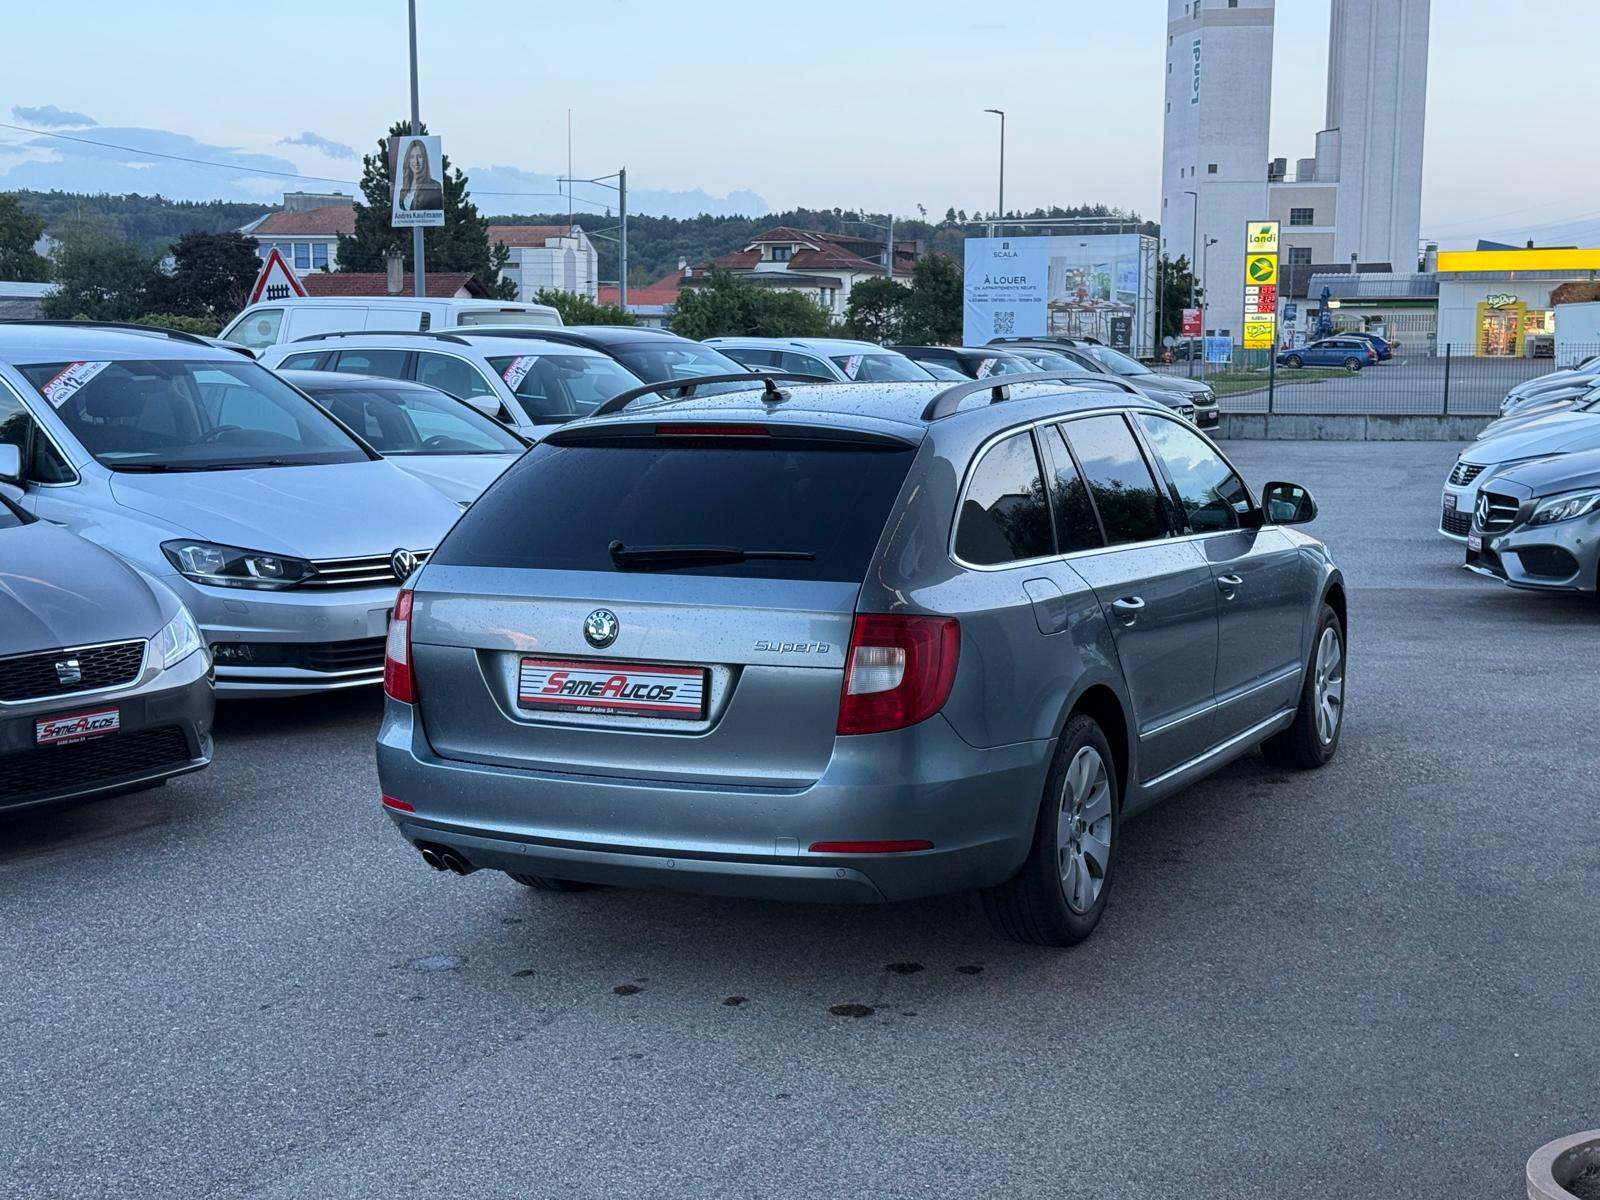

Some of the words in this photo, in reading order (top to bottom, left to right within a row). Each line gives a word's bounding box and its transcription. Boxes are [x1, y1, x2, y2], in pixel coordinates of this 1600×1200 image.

[1191, 39, 1201, 105] Landi
[1249, 233, 1277, 243] Landi
[983, 274, 991, 285] À
[993, 276, 1026, 285] LOUER
[63, 377, 85, 390] 12
[753, 639, 830, 654] Superb
